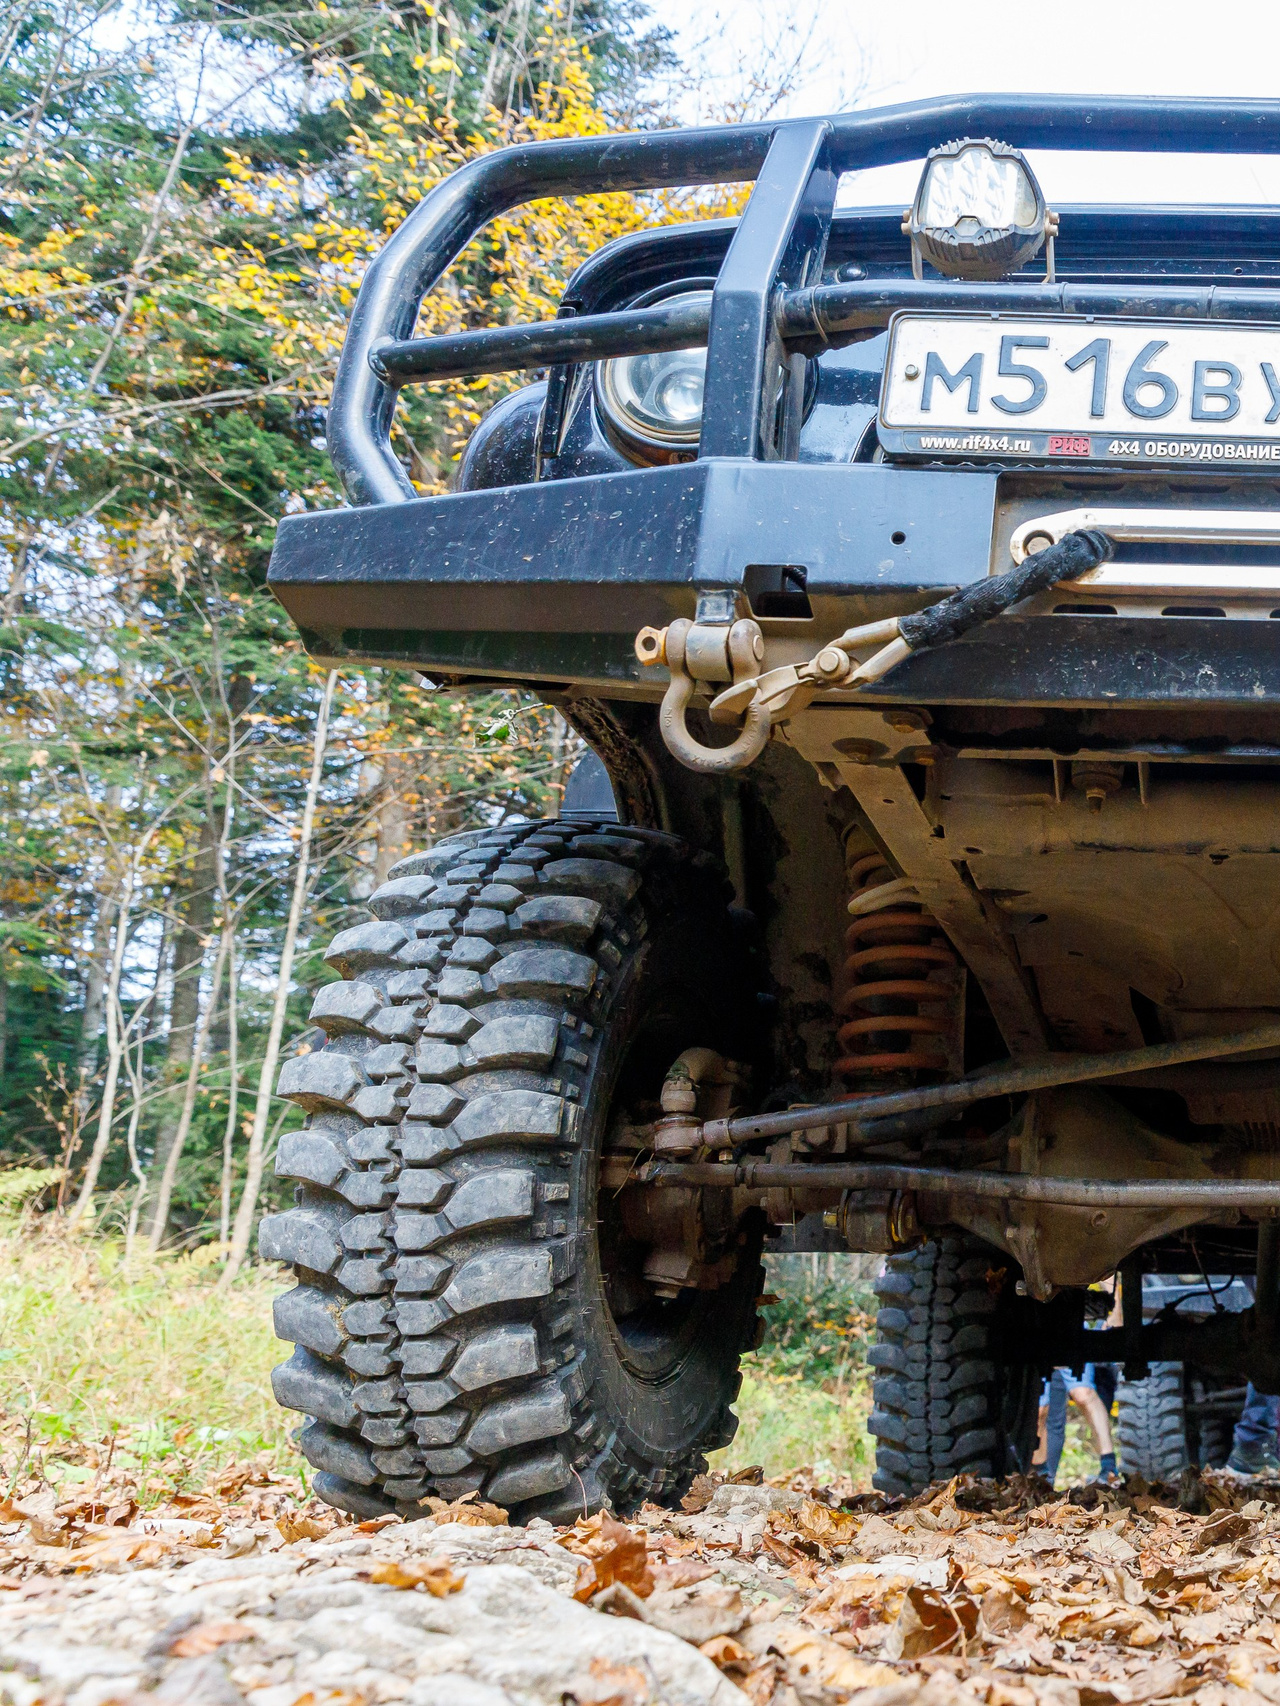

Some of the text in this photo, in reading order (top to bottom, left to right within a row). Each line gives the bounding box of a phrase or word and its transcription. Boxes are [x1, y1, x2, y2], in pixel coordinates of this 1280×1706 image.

[920, 435, 1031, 452] www.rif4x4.ru
[1050, 437, 1090, 454] РИФ
[1144, 441, 1280, 460] ОБОРУДОВАНИЕ
